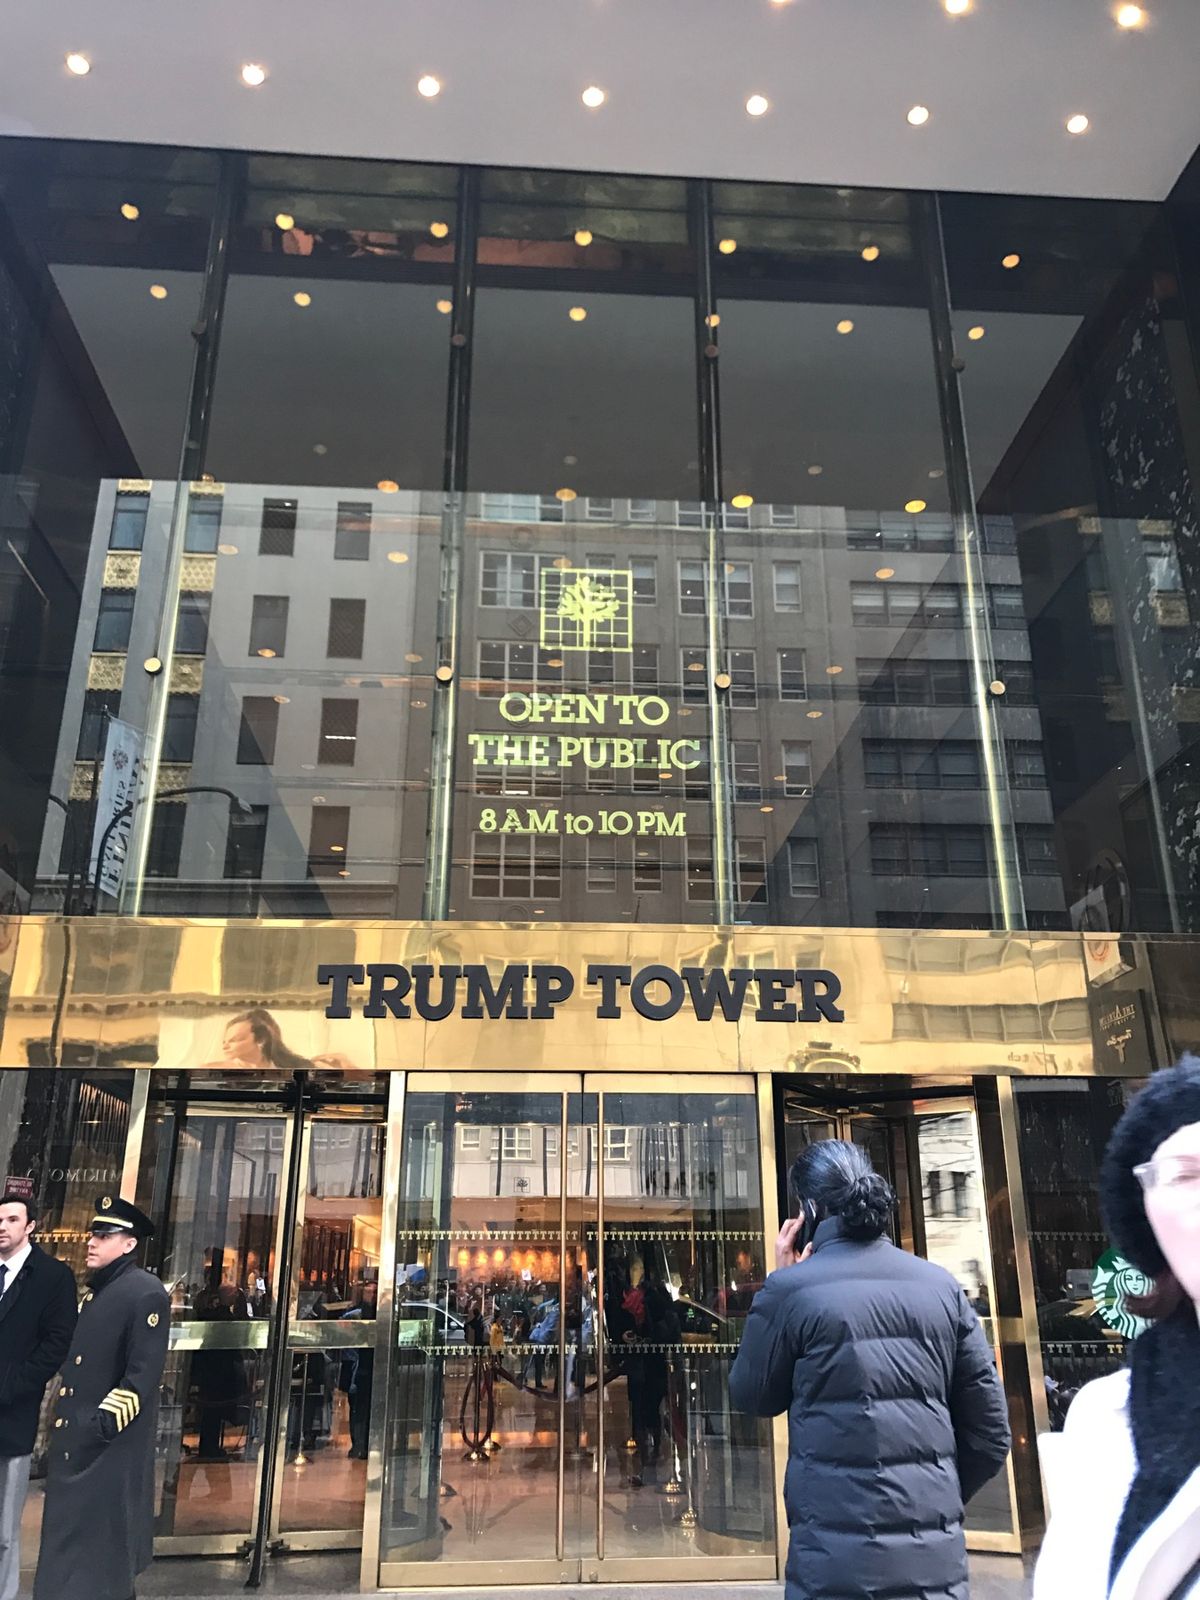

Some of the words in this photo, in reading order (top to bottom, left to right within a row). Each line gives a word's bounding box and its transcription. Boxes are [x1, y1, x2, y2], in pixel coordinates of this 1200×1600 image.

[499, 692, 608, 724] OPEN
[613, 695, 670, 726] TO
[468, 734, 549, 766] THE
[557, 736, 700, 770] PUBLIC
[479, 808, 497, 833] 8
[499, 809, 559, 834] AM
[564, 812, 594, 835] to
[598, 810, 633, 836] 10
[637, 811, 687, 836] PM
[317, 963, 574, 1021] TRUMP
[587, 964, 845, 1023] TOWER
